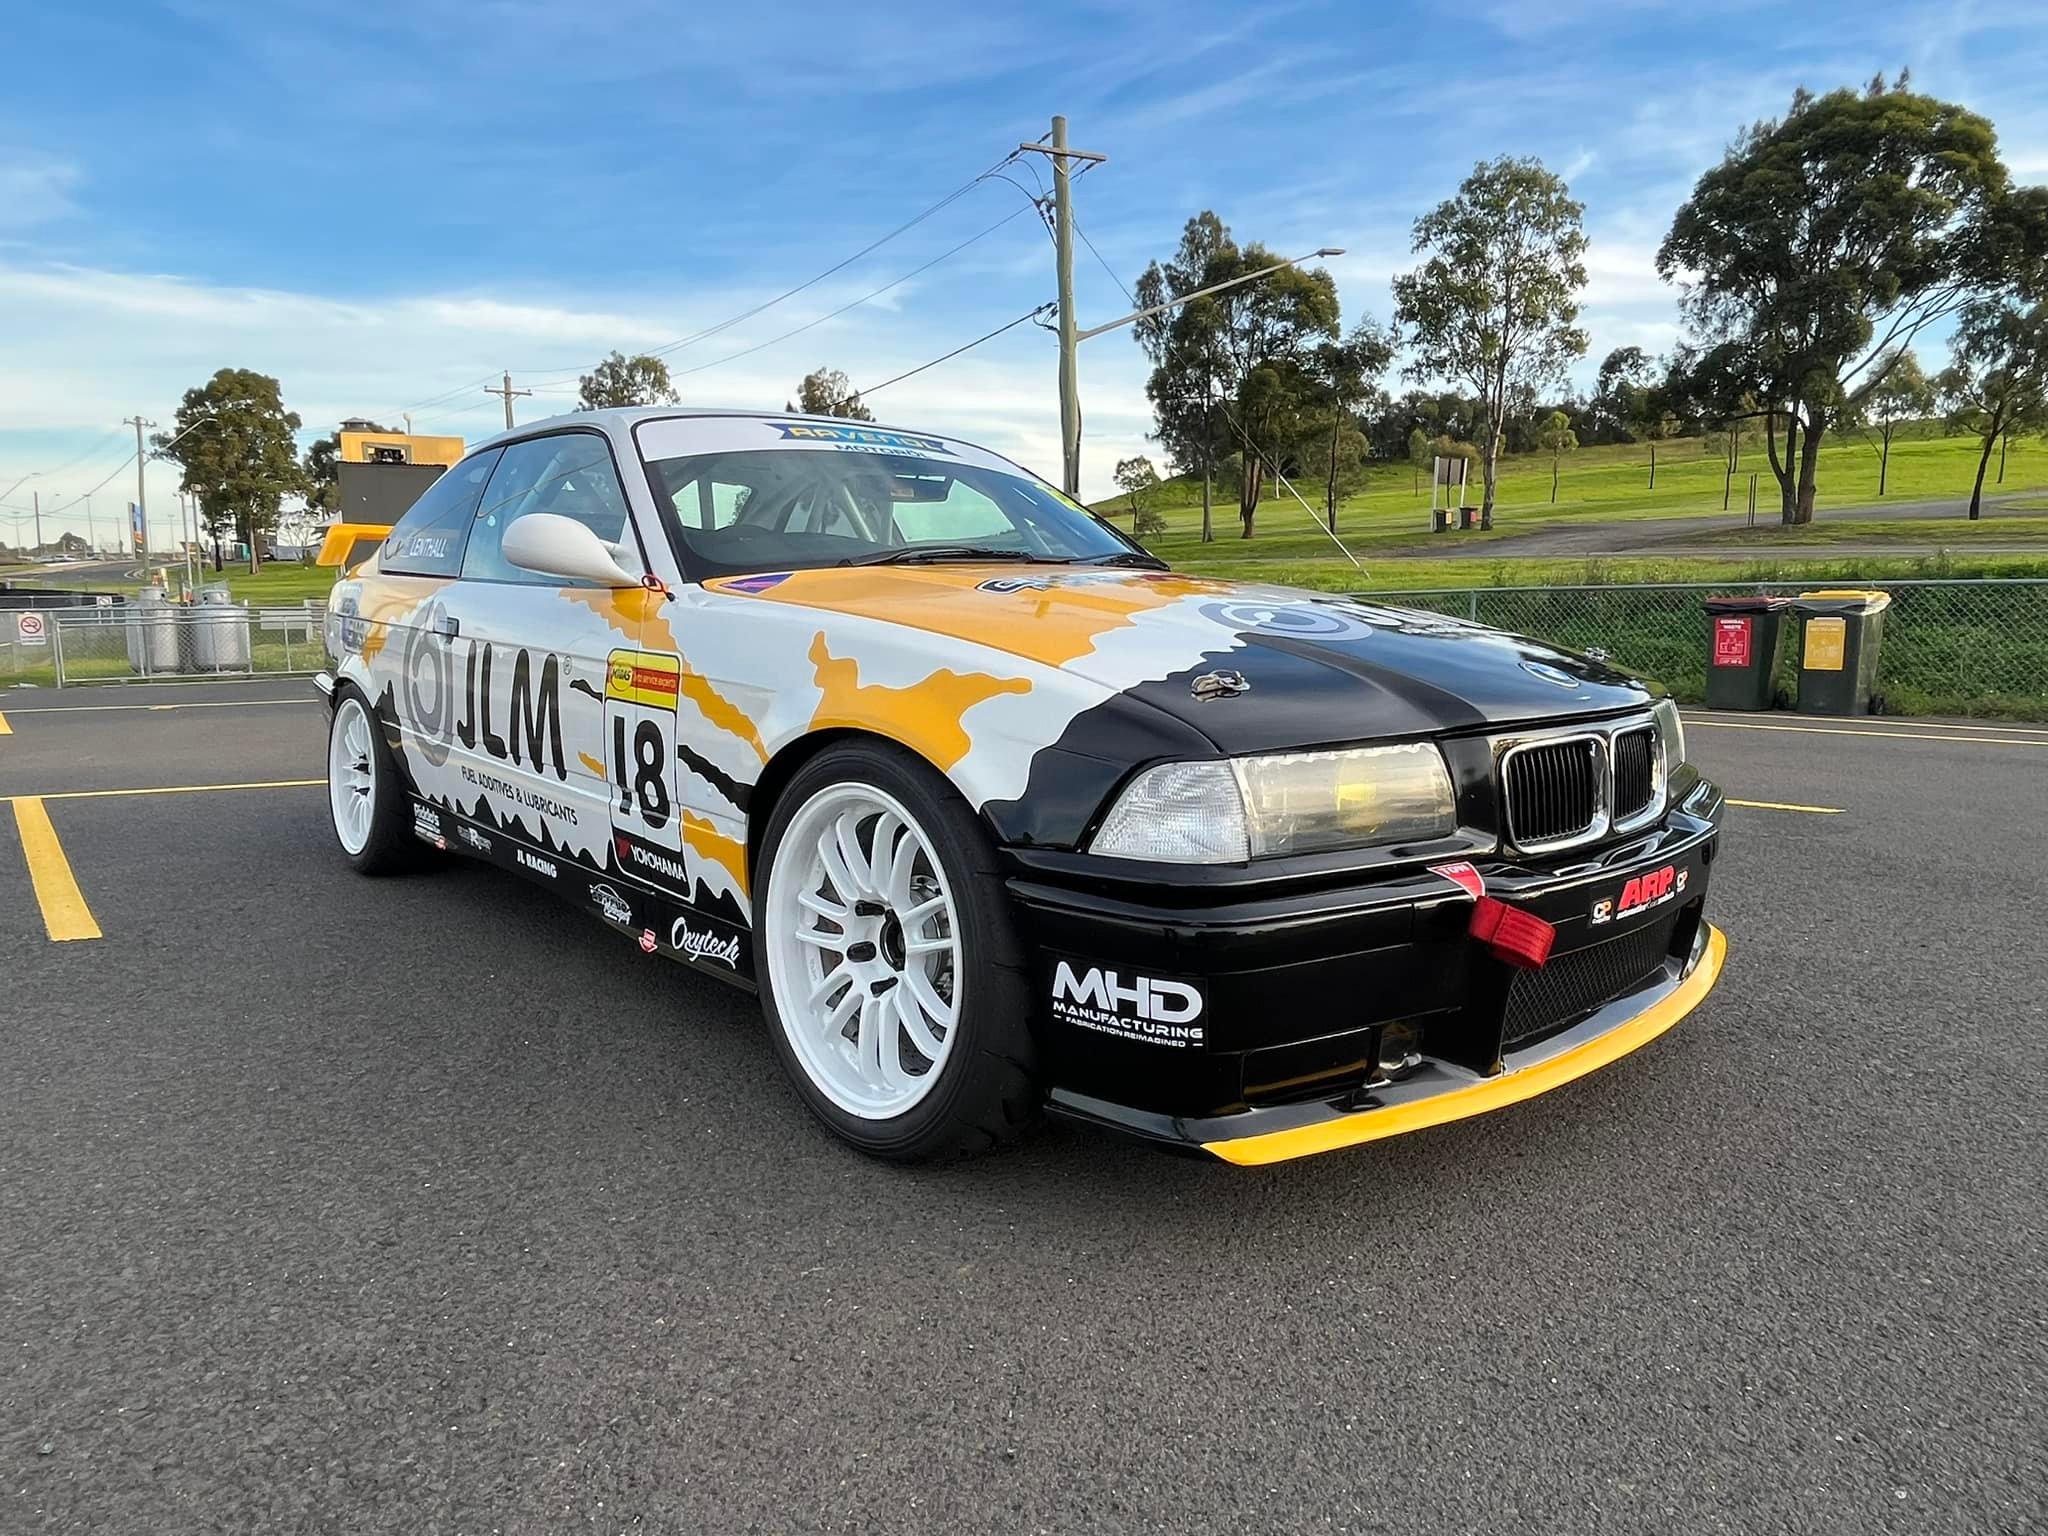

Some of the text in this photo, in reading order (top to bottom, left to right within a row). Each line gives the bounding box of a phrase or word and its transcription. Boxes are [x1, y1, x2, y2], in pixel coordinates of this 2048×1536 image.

[790, 428, 938, 451] RAVENOL
[409, 537, 447, 558] LENTHALL
[457, 639, 567, 782] JLM
[613, 714, 671, 830] 18
[461, 764, 578, 827] FUEL ADDITIVES & LUBRICANTS
[525, 852, 558, 879] RACING
[631, 846, 686, 882] YOKOHAMA
[1437, 864, 1470, 875] TOW
[672, 917, 740, 969] Oxytech
[1052, 961, 1203, 1024] MHD
[1052, 1000, 1204, 1039] MANUFACTURING
[1065, 1016, 1187, 1048] FABRICATION REIMAGINED
